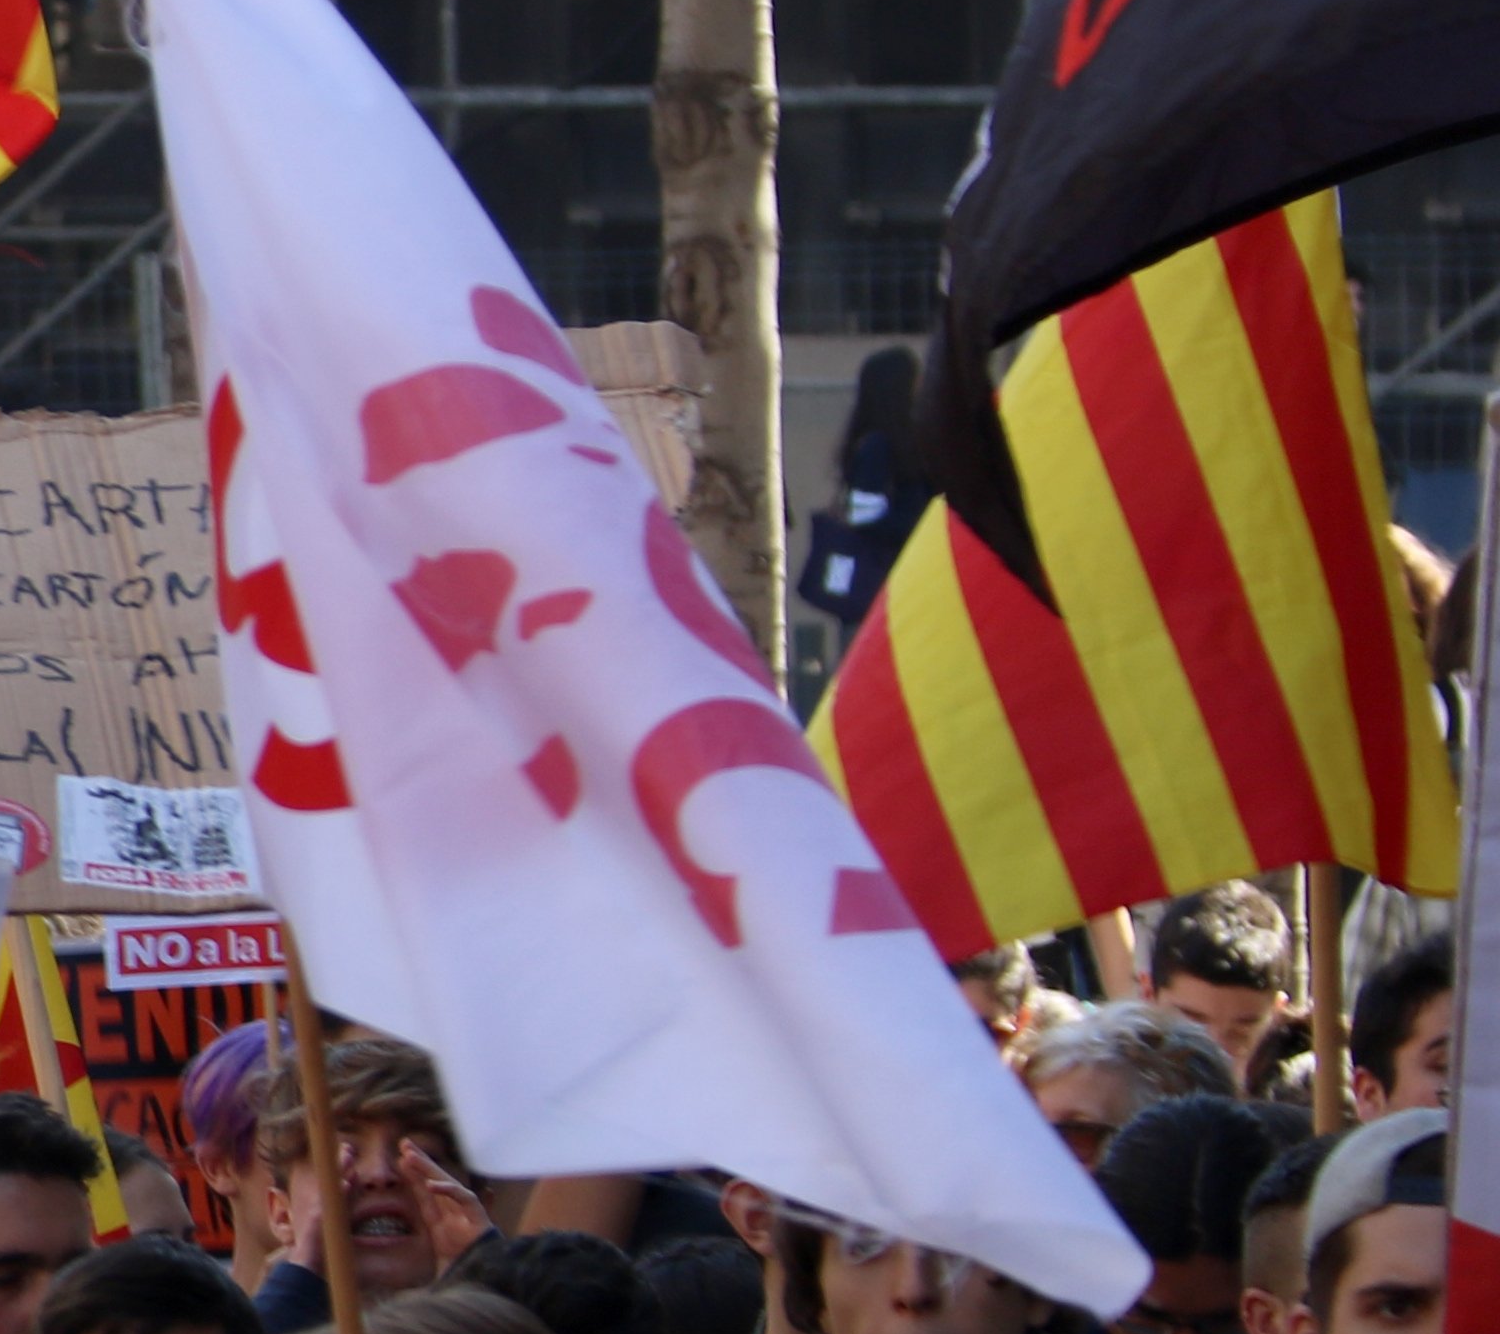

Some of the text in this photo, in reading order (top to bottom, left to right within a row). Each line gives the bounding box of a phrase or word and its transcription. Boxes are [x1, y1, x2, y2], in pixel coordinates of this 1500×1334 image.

[121, 929, 192, 969] NO
[196, 938, 221, 965] a
[225, 926, 262, 964] la
